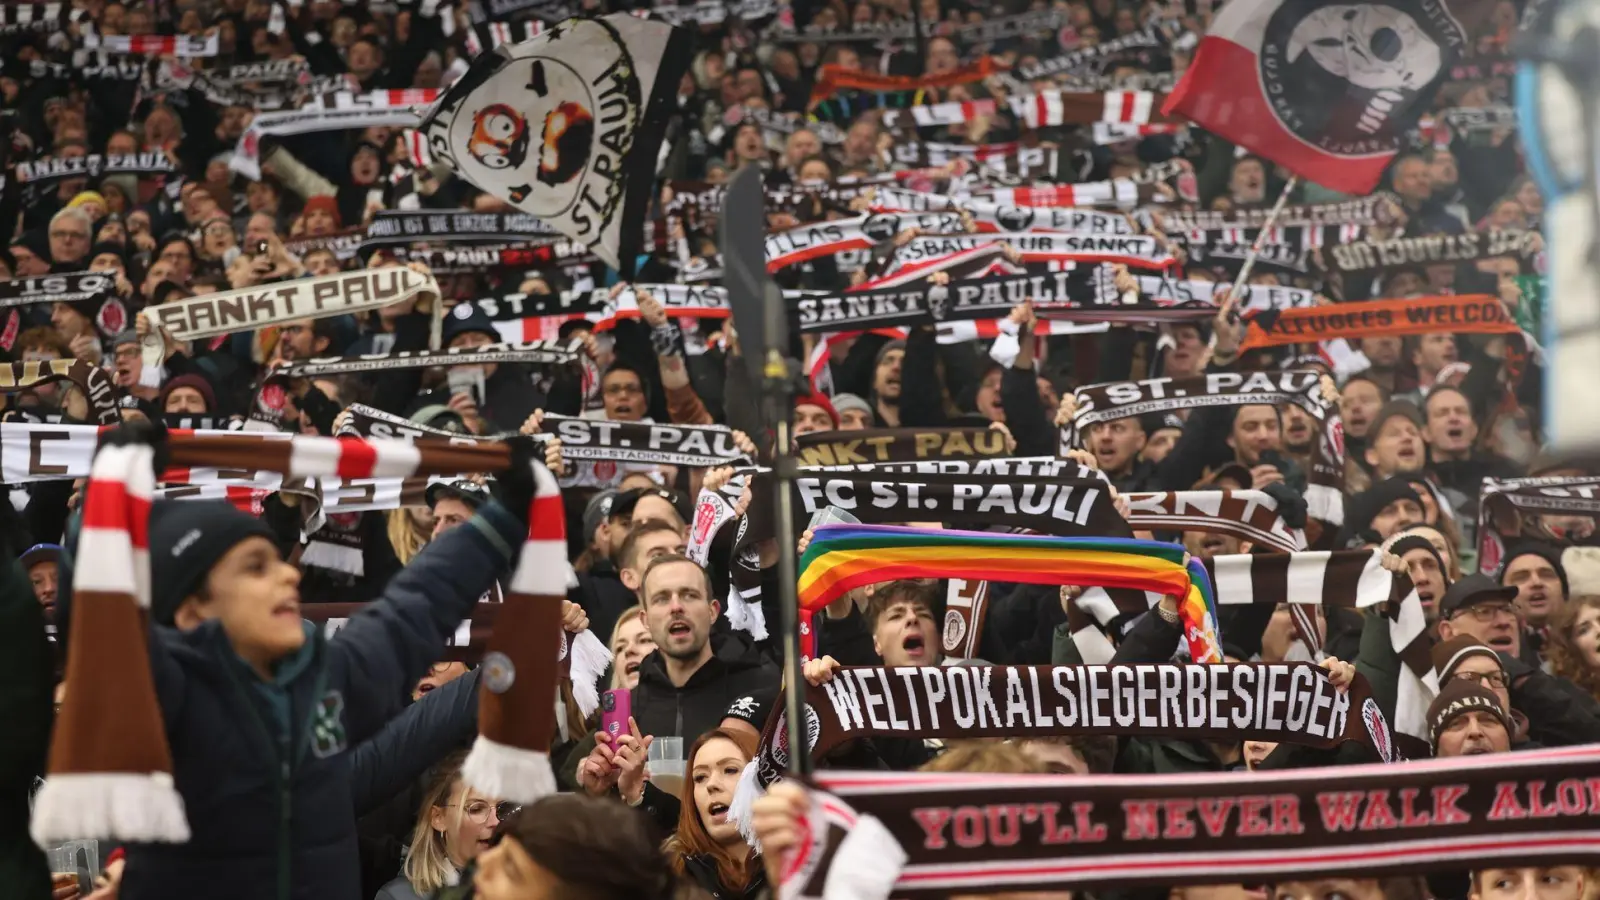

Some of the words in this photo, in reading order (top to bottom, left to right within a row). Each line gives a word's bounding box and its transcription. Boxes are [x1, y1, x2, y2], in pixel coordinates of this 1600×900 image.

[1067, 236, 1146, 253] SANKT
[158, 287, 301, 333] SANKT
[799, 291, 924, 322] SANKT
[956, 271, 1071, 305] PAULI
[1105, 377, 1186, 404] ST.
[558, 420, 632, 447] ST.
[796, 478, 858, 514] FC
[871, 481, 938, 510] ST.
[953, 484, 1100, 526] PAULI
[823, 663, 1348, 740] WELTPOKALSIEGERBESIEGER
[913, 801, 1107, 850] YOU'LL
[1122, 795, 1304, 840] NEVER
[1316, 784, 1470, 831] WALK
